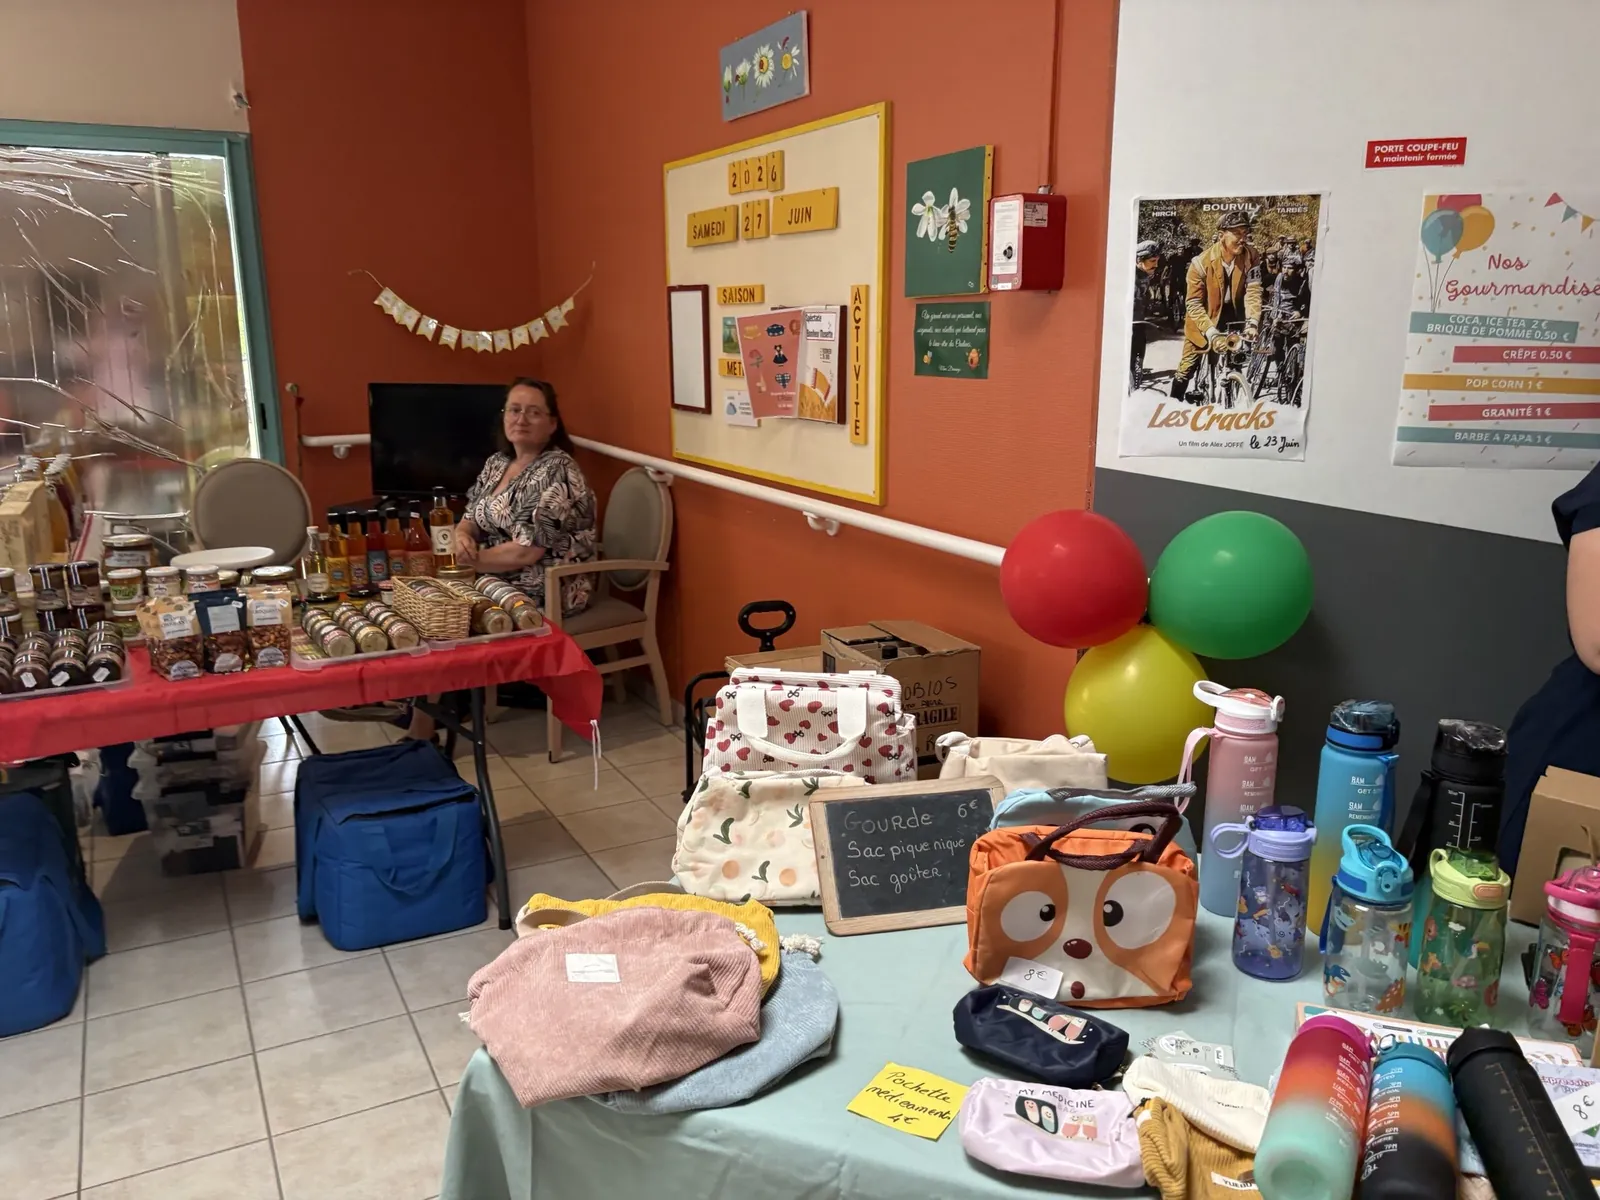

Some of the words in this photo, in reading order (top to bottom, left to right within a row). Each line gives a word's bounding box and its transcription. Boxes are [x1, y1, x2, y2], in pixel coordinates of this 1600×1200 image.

[1374, 144, 1404, 154] PORTE
[1406, 142, 1459, 153] COUPE-FEU
[1382, 153, 1424, 163] maintenir
[1426, 152, 1457, 162] fermée
[1202, 202, 1256, 212] BOURVIL
[692, 219, 726, 240] SAMEDI
[744, 212, 762, 232] 27
[787, 205, 812, 226] JUIN
[1487, 253, 1530, 272] Nos
[721, 287, 756, 304] SAISON
[1449, 314, 1482, 325] COCA,
[1486, 315, 1502, 326] ICE
[1506, 317, 1526, 328] TEA
[1531, 319, 1539, 329] 2
[1541, 320, 1549, 330] €
[1426, 323, 1468, 335] BRIQUE
[1471, 325, 1486, 336] DE
[1488, 327, 1532, 339] POMME
[1534, 329, 1558, 341] 0.50
[1562, 331, 1570, 342] €
[852, 287, 863, 437] ACTIVITE
[1502, 348, 1537, 360] CRÊPE
[1539, 350, 1563, 360] 0.50
[1565, 350, 1572, 361] €
[726, 360, 745, 376] MET
[1465, 377, 1489, 388] POP
[1491, 378, 1524, 389] CORN
[1528, 380, 1533, 390] 1
[1536, 380, 1544, 390] €
[1147, 402, 1192, 429] Les
[1190, 402, 1277, 432] Cracks
[1481, 405, 1533, 418] GRANITÉ
[1535, 407, 1541, 416] 1
[1544, 407, 1551, 416] €
[1250, 434, 1262, 450] le
[1263, 436, 1278, 447] 23
[1277, 436, 1300, 453] Juin
[1454, 431, 1490, 442] BARBE
[1503, 433, 1533, 443] PAPA
[1536, 434, 1542, 444] 1
[1544, 434, 1552, 444] €
[901, 677, 957, 701] OBIOS
[914, 706, 958, 726] RAGILE
[847, 840, 886, 859] Sac
[890, 840, 930, 861] pique
[933, 837, 966, 856] nique
[848, 869, 880, 888] Sac
[886, 1071, 951, 1103] Pochette
[1018, 1088, 1035, 1096] MY
[1041, 1090, 1095, 1109] MEDICINE
